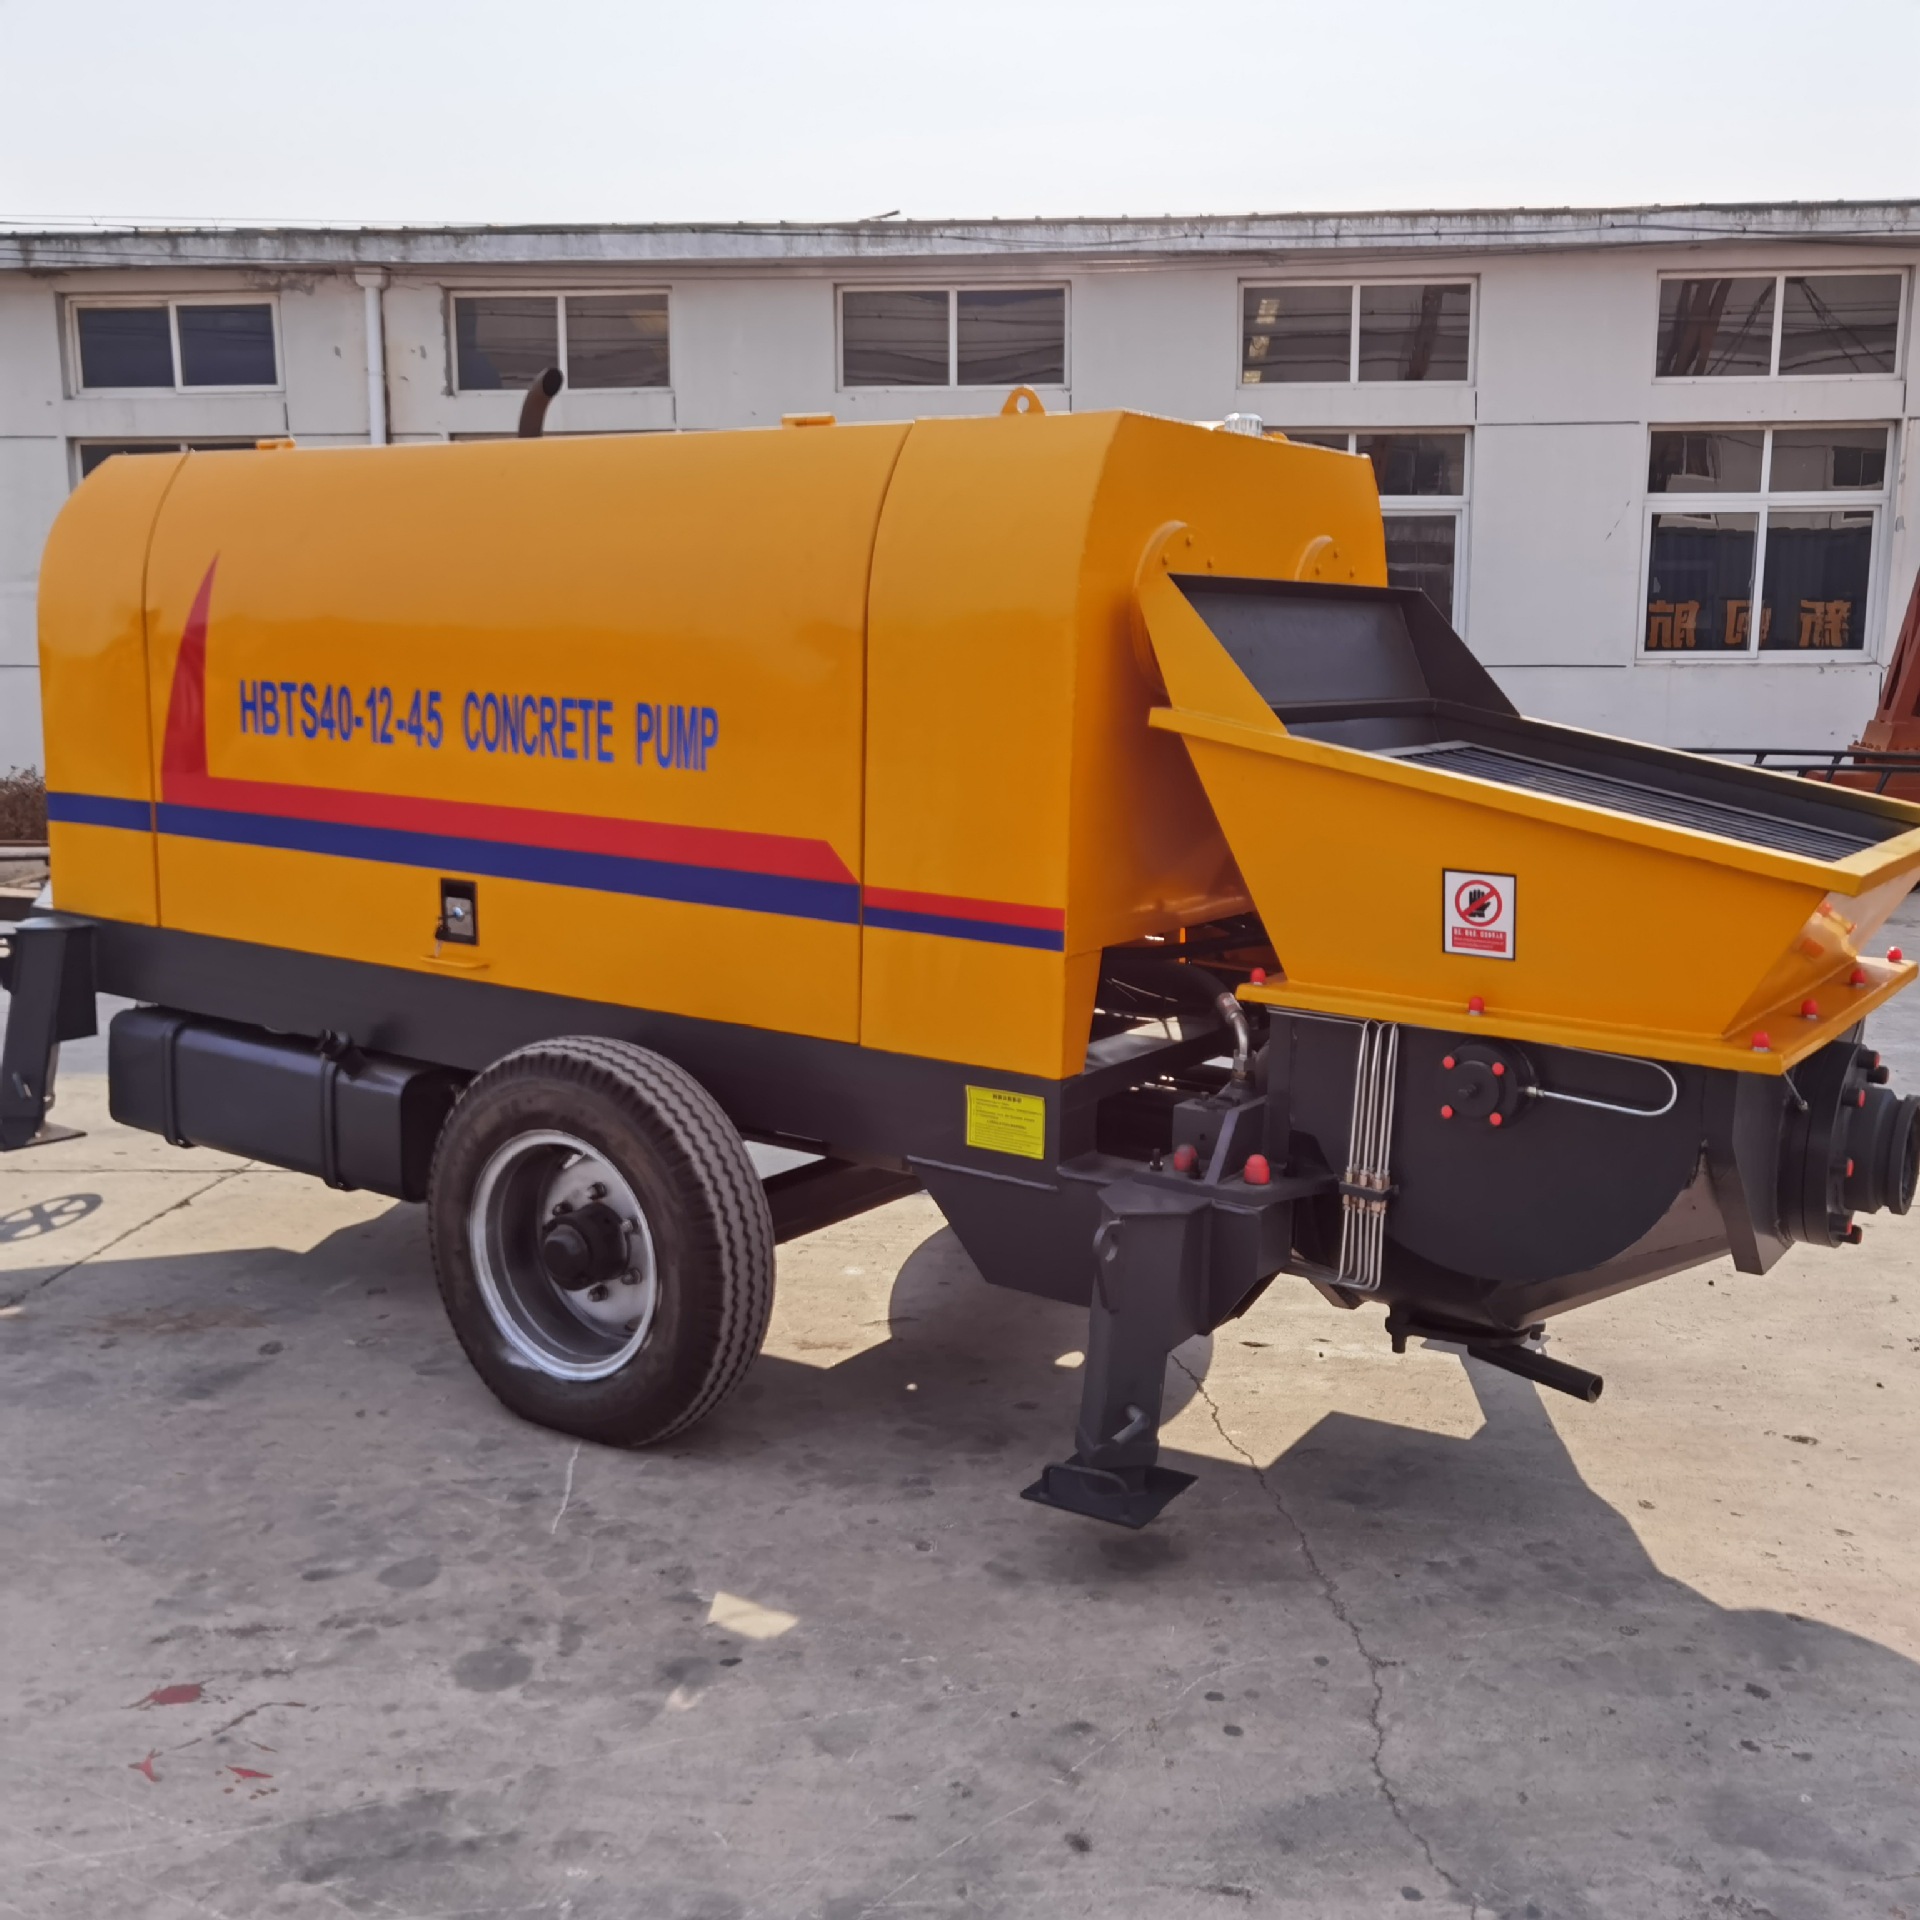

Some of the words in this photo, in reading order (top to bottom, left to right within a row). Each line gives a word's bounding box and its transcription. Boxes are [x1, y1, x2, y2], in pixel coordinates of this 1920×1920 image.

[240, 680, 443, 749] HBTS40-12-45
[464, 691, 614, 763] CONCRETE
[636, 702, 719, 771] PUMP
